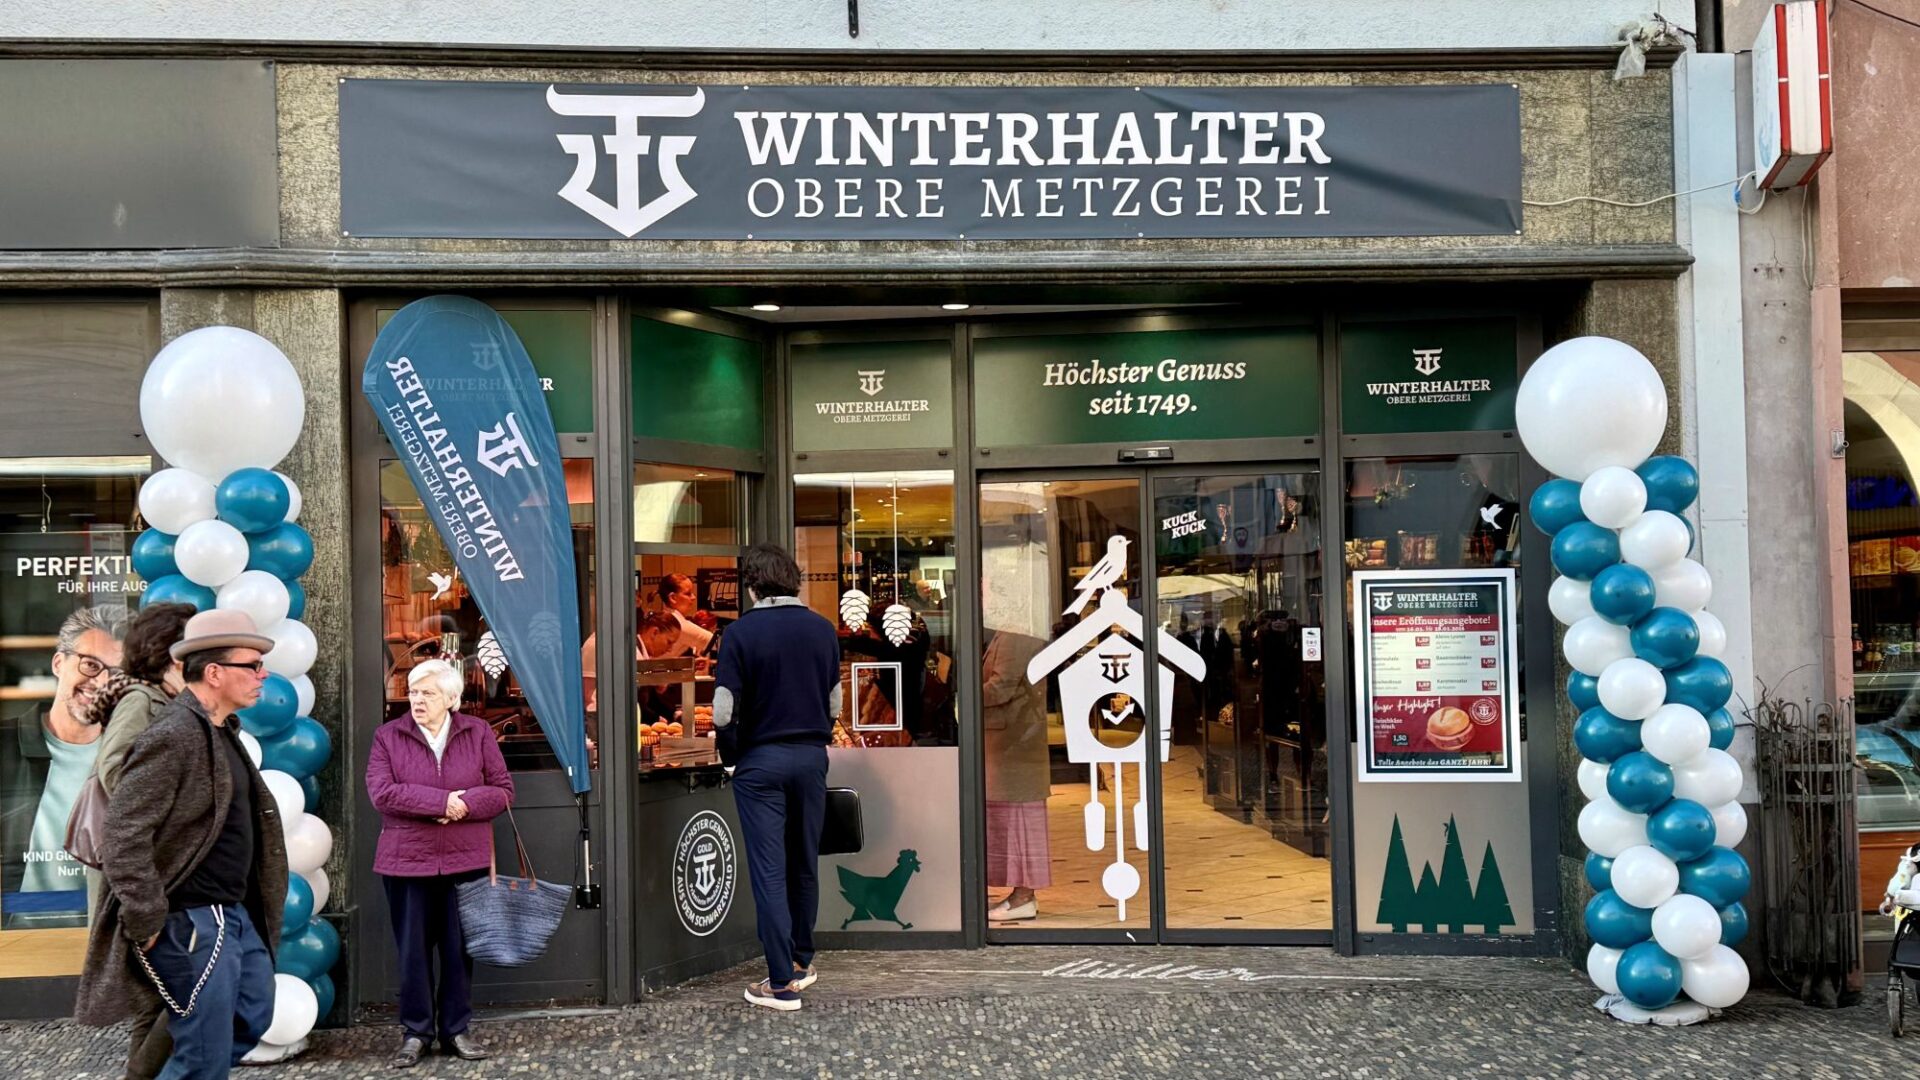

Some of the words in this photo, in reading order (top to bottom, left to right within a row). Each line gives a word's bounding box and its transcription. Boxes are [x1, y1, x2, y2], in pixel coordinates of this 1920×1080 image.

[733, 111, 1332, 167] WINTERHALTER
[747, 177, 945, 218] OBERE
[980, 176, 1331, 218] METZGEREI
[1042, 360, 1154, 386] Höchster
[1157, 359, 1247, 382] Genuss
[1366, 379, 1491, 395] WINTERHALTER
[1088, 390, 1134, 416] seit
[1136, 393, 1198, 416] 1749.
[1386, 395, 1417, 404] OBERE
[1418, 393, 1471, 403] METZGEREI
[815, 400, 930, 414] WINTERHALTER
[833, 415, 862, 423] OBERE
[863, 413, 911, 422] METZGEREI
[1162, 510, 1198, 530] KUCK
[1171, 519, 1207, 539] KUCK
[16, 556, 137, 576] PERFEKTI
[57, 580, 84, 593] FÜR
[87, 581, 119, 592] IHRE
[1396, 592, 1478, 602] WINTERHALTER
[1398, 616, 1491, 627] Eröffnungsangebote!
[1393, 734, 1407, 742] 1,50
[1440, 758, 1467, 766] GANZE
[678, 818, 709, 862] HÖCHSTER
[709, 819, 731, 853] GENUSS
[697, 842, 713, 854] GOLD
[23, 851, 53, 862] KIND
[58, 865, 80, 876] Nur
[676, 875, 687, 901] AUS
[694, 865, 733, 927] SCHWARZWALD
[681, 901, 695, 923] DEM
